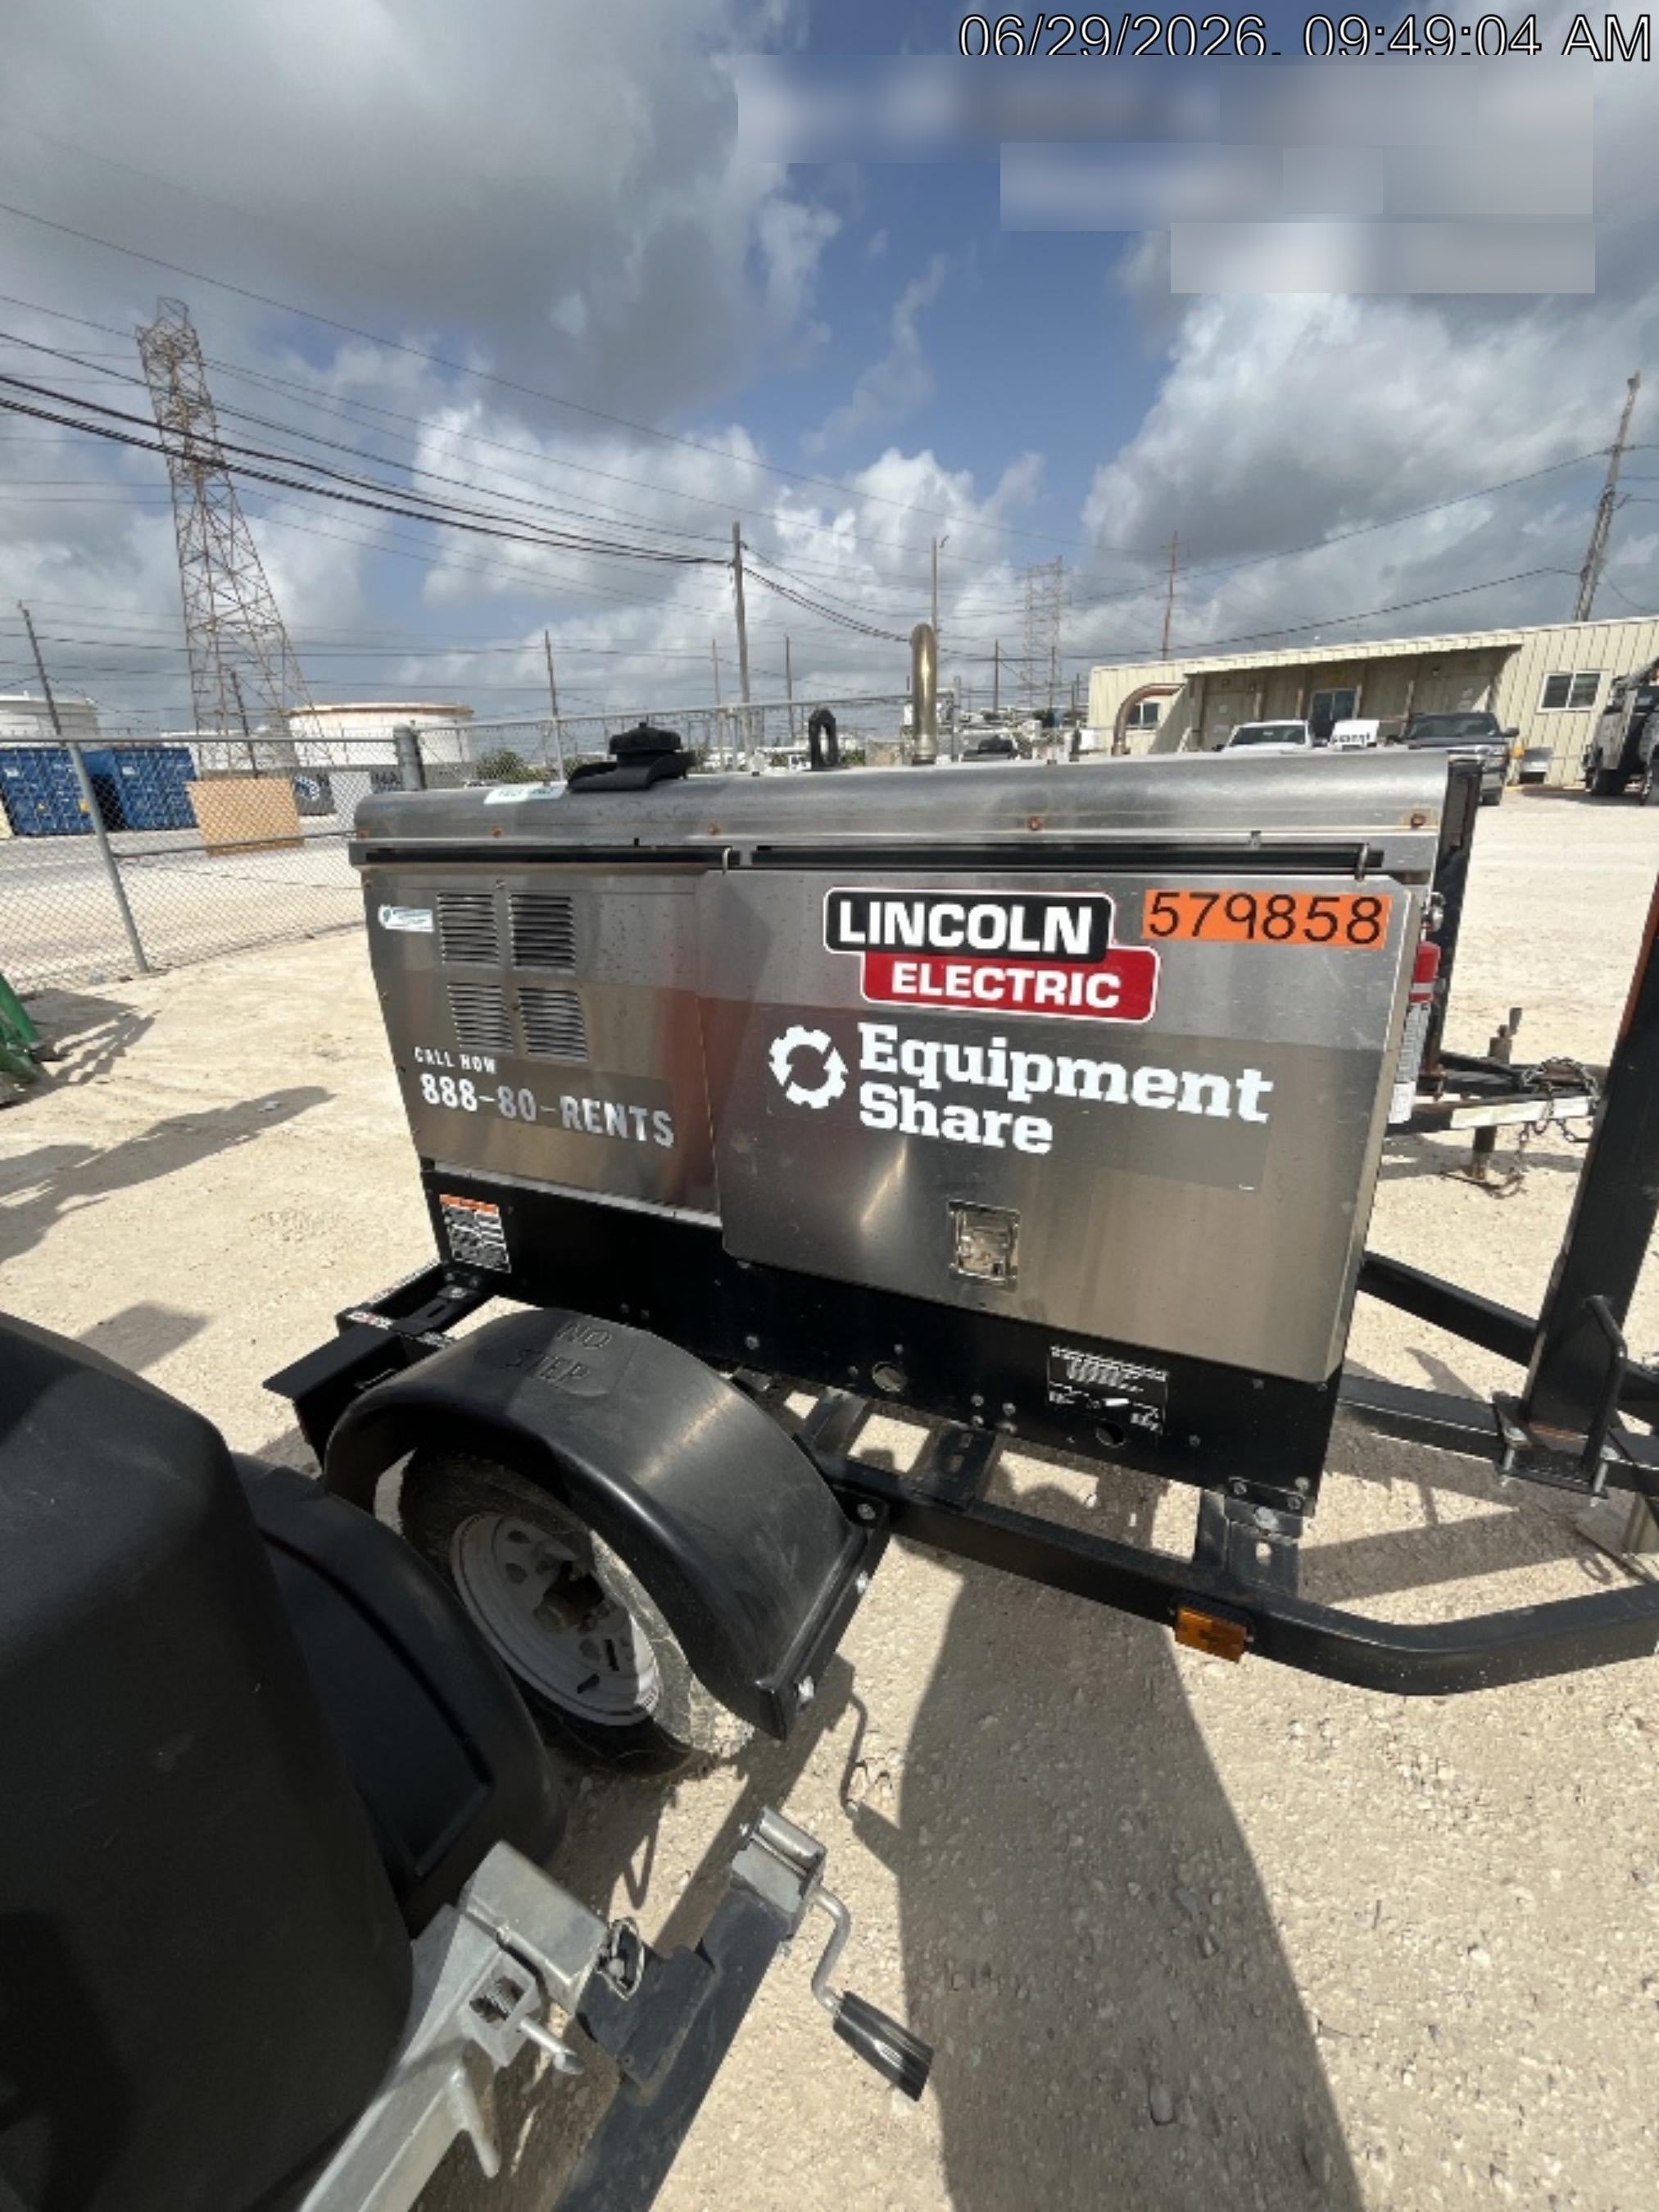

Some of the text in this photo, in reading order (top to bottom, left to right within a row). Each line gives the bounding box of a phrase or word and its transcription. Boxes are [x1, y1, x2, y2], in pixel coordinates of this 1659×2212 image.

[840, 900, 1092, 956] LINCOLN
[1149, 891, 1384, 945] 579858
[892, 960, 1121, 1009] ELECTRIC
[415, 1046, 455, 1067] CALL
[858, 1022, 1274, 1125] Equipment
[419, 1072, 674, 1148] 888-80-RENTS
[859, 1081, 1054, 1156] Share
